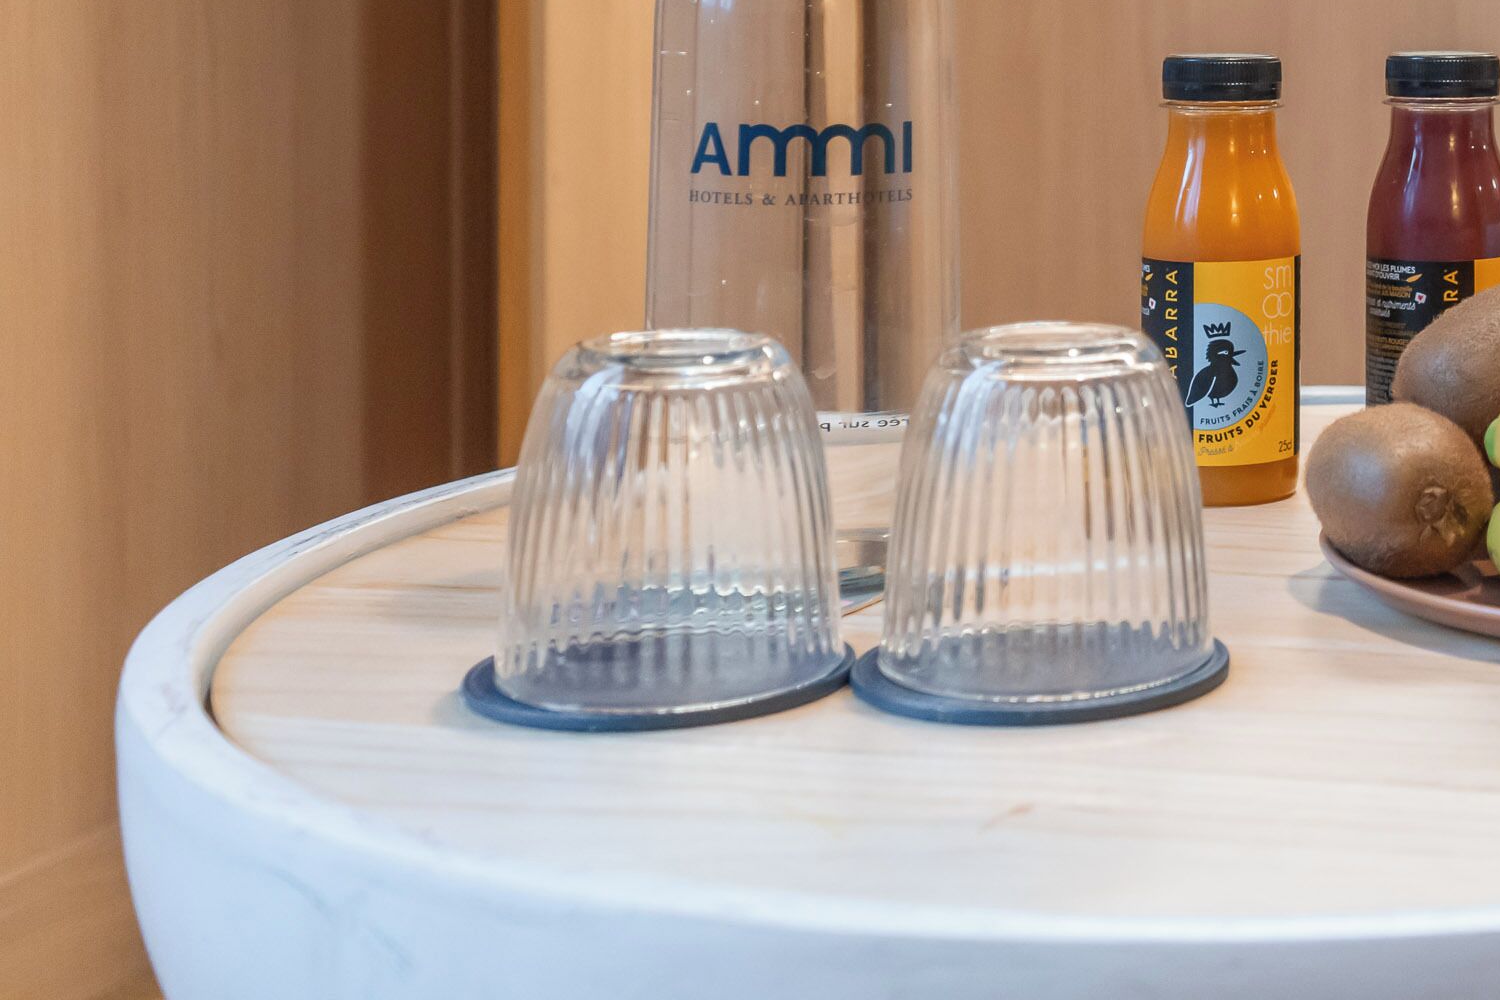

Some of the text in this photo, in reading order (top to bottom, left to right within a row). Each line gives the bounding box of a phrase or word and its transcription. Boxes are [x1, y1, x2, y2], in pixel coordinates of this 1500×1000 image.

[689, 188, 913, 207] HOTELS & APARTHOTELS
[1390, 265, 1416, 274] PLUMES
[1198, 426, 1244, 444] FRUITS
[1245, 411, 1261, 428] DU
[1259, 359, 1279, 409] VERGER
[1200, 414, 1231, 425] FRUITS
[1232, 396, 1253, 417] FRAIS
[1254, 360, 1264, 388] BOIRE
